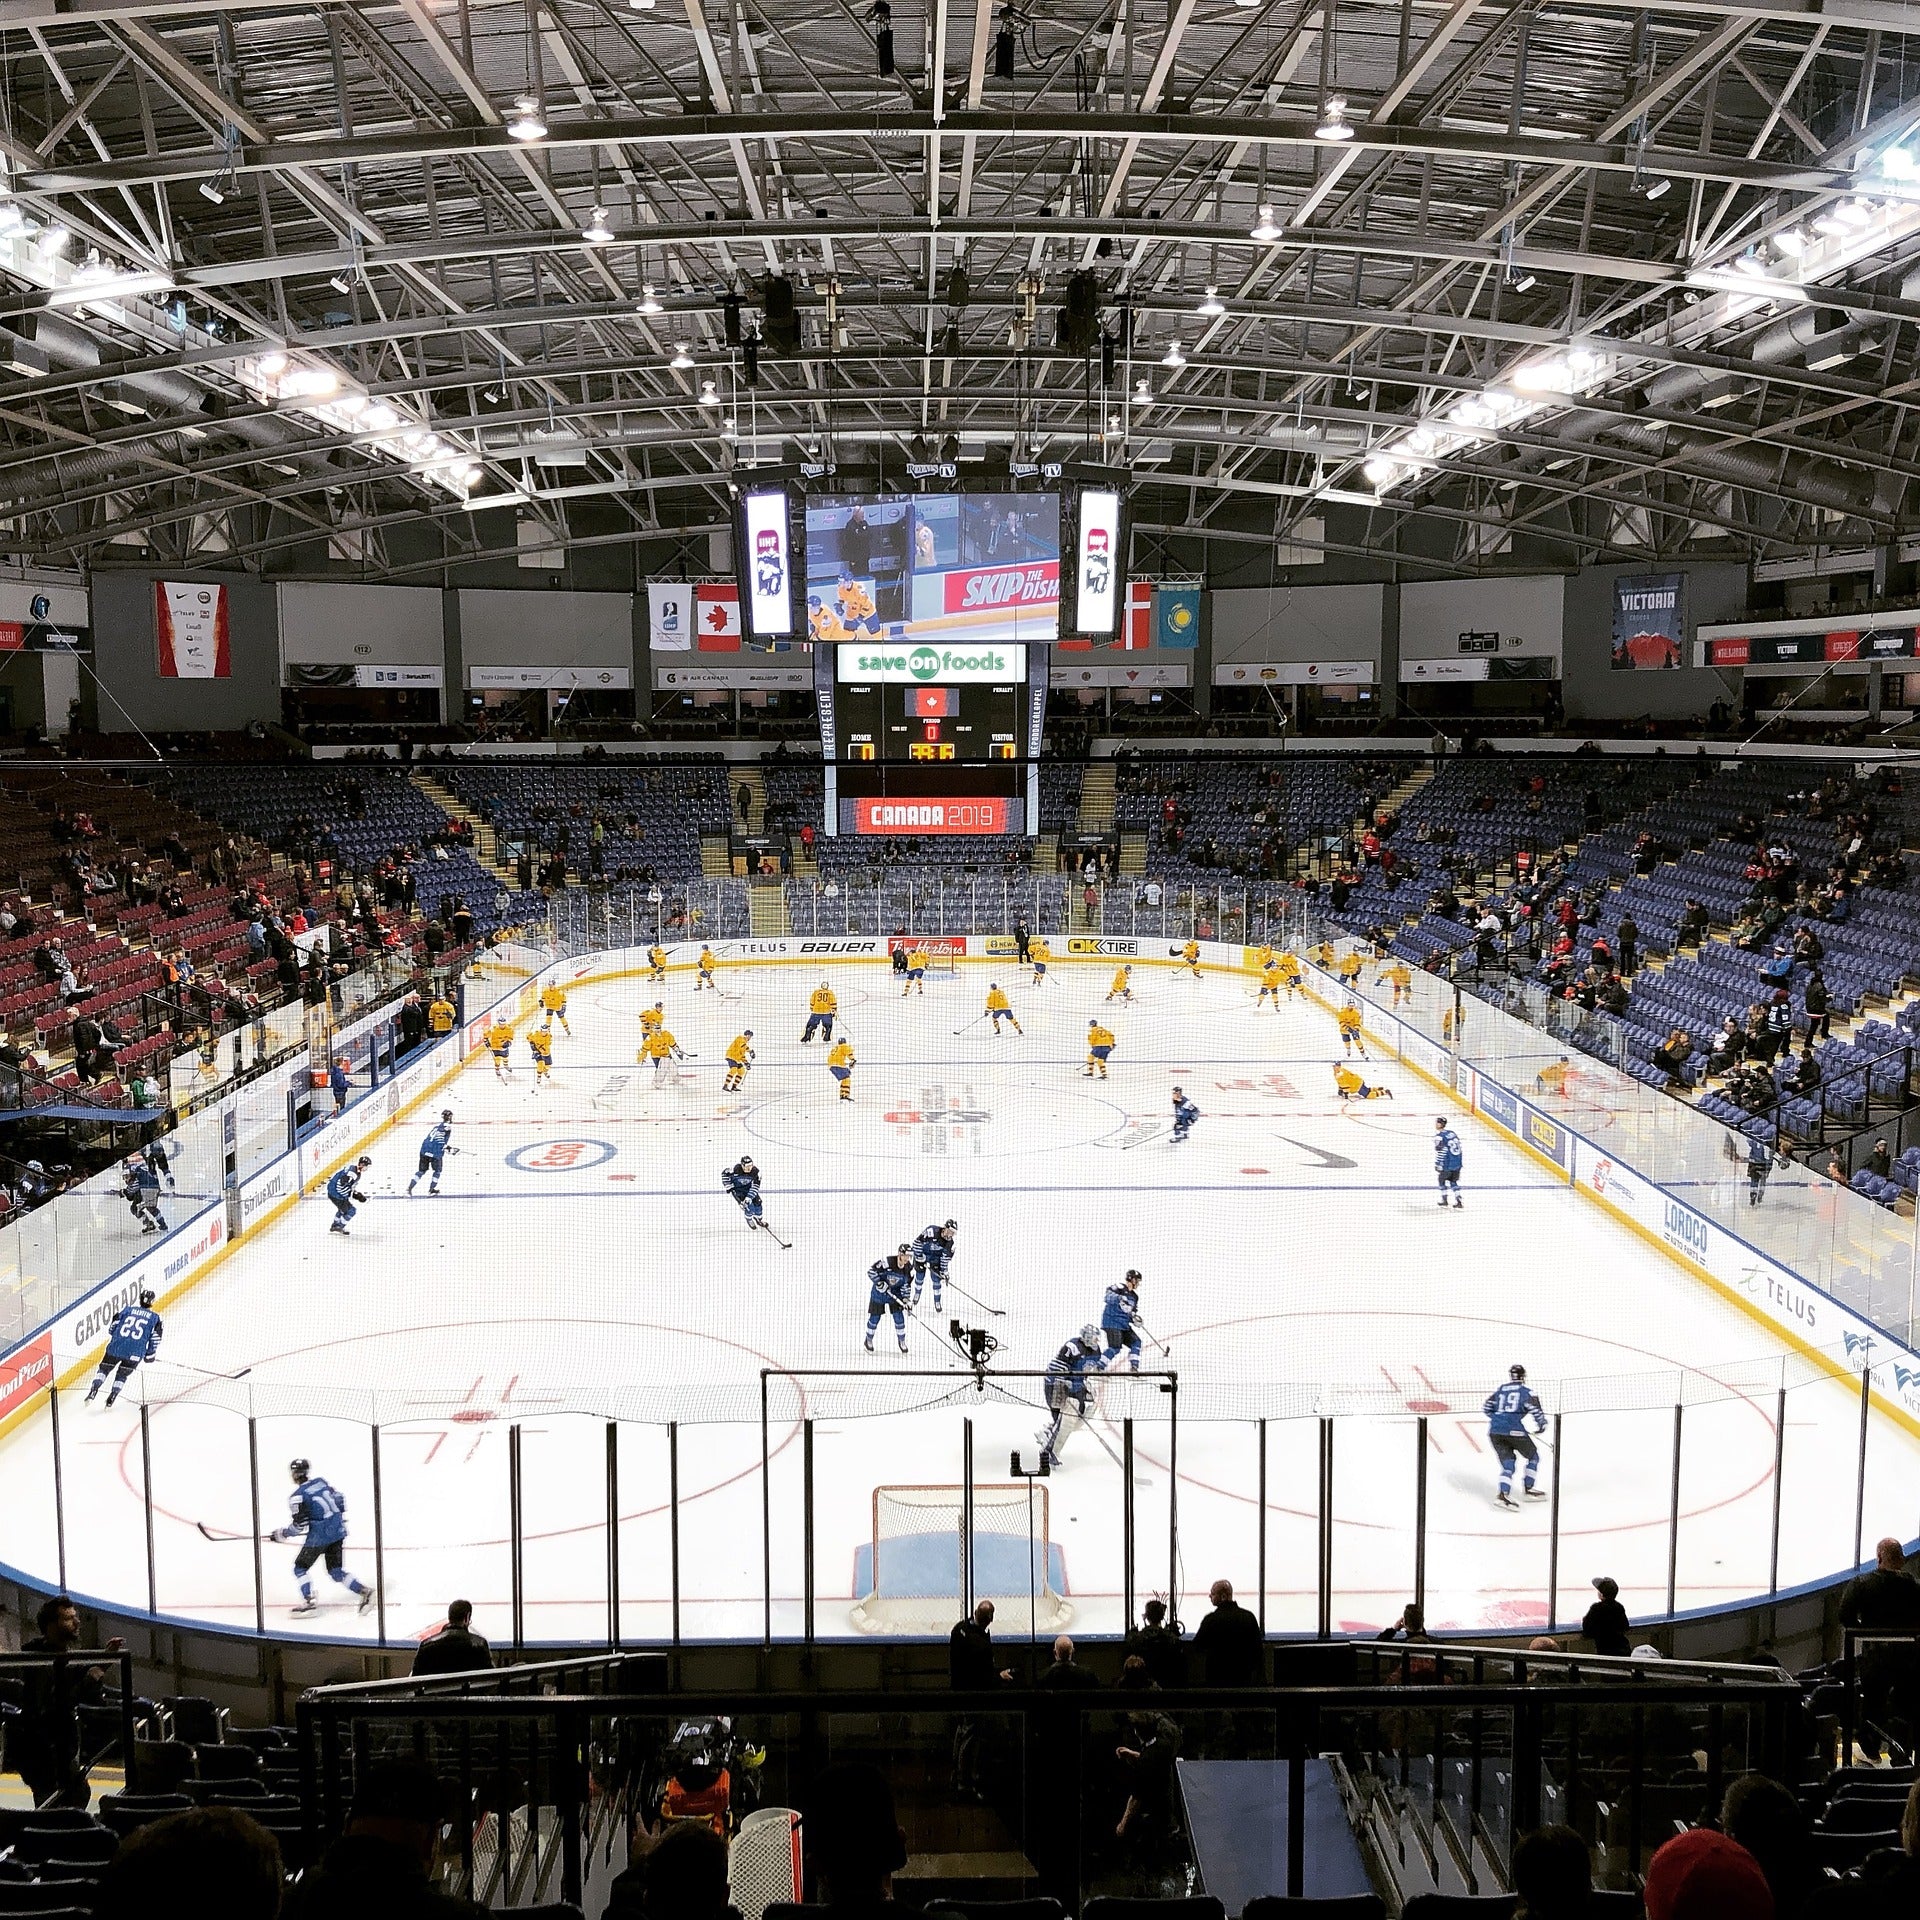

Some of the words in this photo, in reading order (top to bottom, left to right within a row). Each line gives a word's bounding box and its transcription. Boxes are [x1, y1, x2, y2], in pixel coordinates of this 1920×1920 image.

[801, 464, 835, 473] ROYAS
[940, 466, 955, 475] TV
[1045, 466, 1060, 475] TV
[1027, 570, 1043, 581] THE
[962, 572, 1025, 607] SKIP
[1021, 578, 1059, 600] DISH
[1621, 592, 1675, 610] VICTORIA
[858, 656, 906, 671] save
[909, 655, 938, 670] on
[942, 651, 1005, 671] foods
[927, 726, 936, 740] 0
[991, 733, 1014, 741] VISITOR
[870, 804, 944, 827] CANADA
[948, 804, 994, 827] 2019
[740, 943, 787, 953] TELUS
[800, 942, 876, 952] BAUER
[1069, 939, 1100, 953] OK
[1107, 942, 1136, 953] TIRE
[817, 993, 829, 1003] 30
[1664, 1200, 1708, 1254] LORDCO
[163, 1252, 190, 1282] TIMBER
[190, 1236, 208, 1260] MART
[1767, 1276, 1817, 1328] TELUS
[75, 1275, 146, 1347] GATORADE
[120, 1315, 149, 1340] 25
[1497, 1391, 1521, 1413] 19
